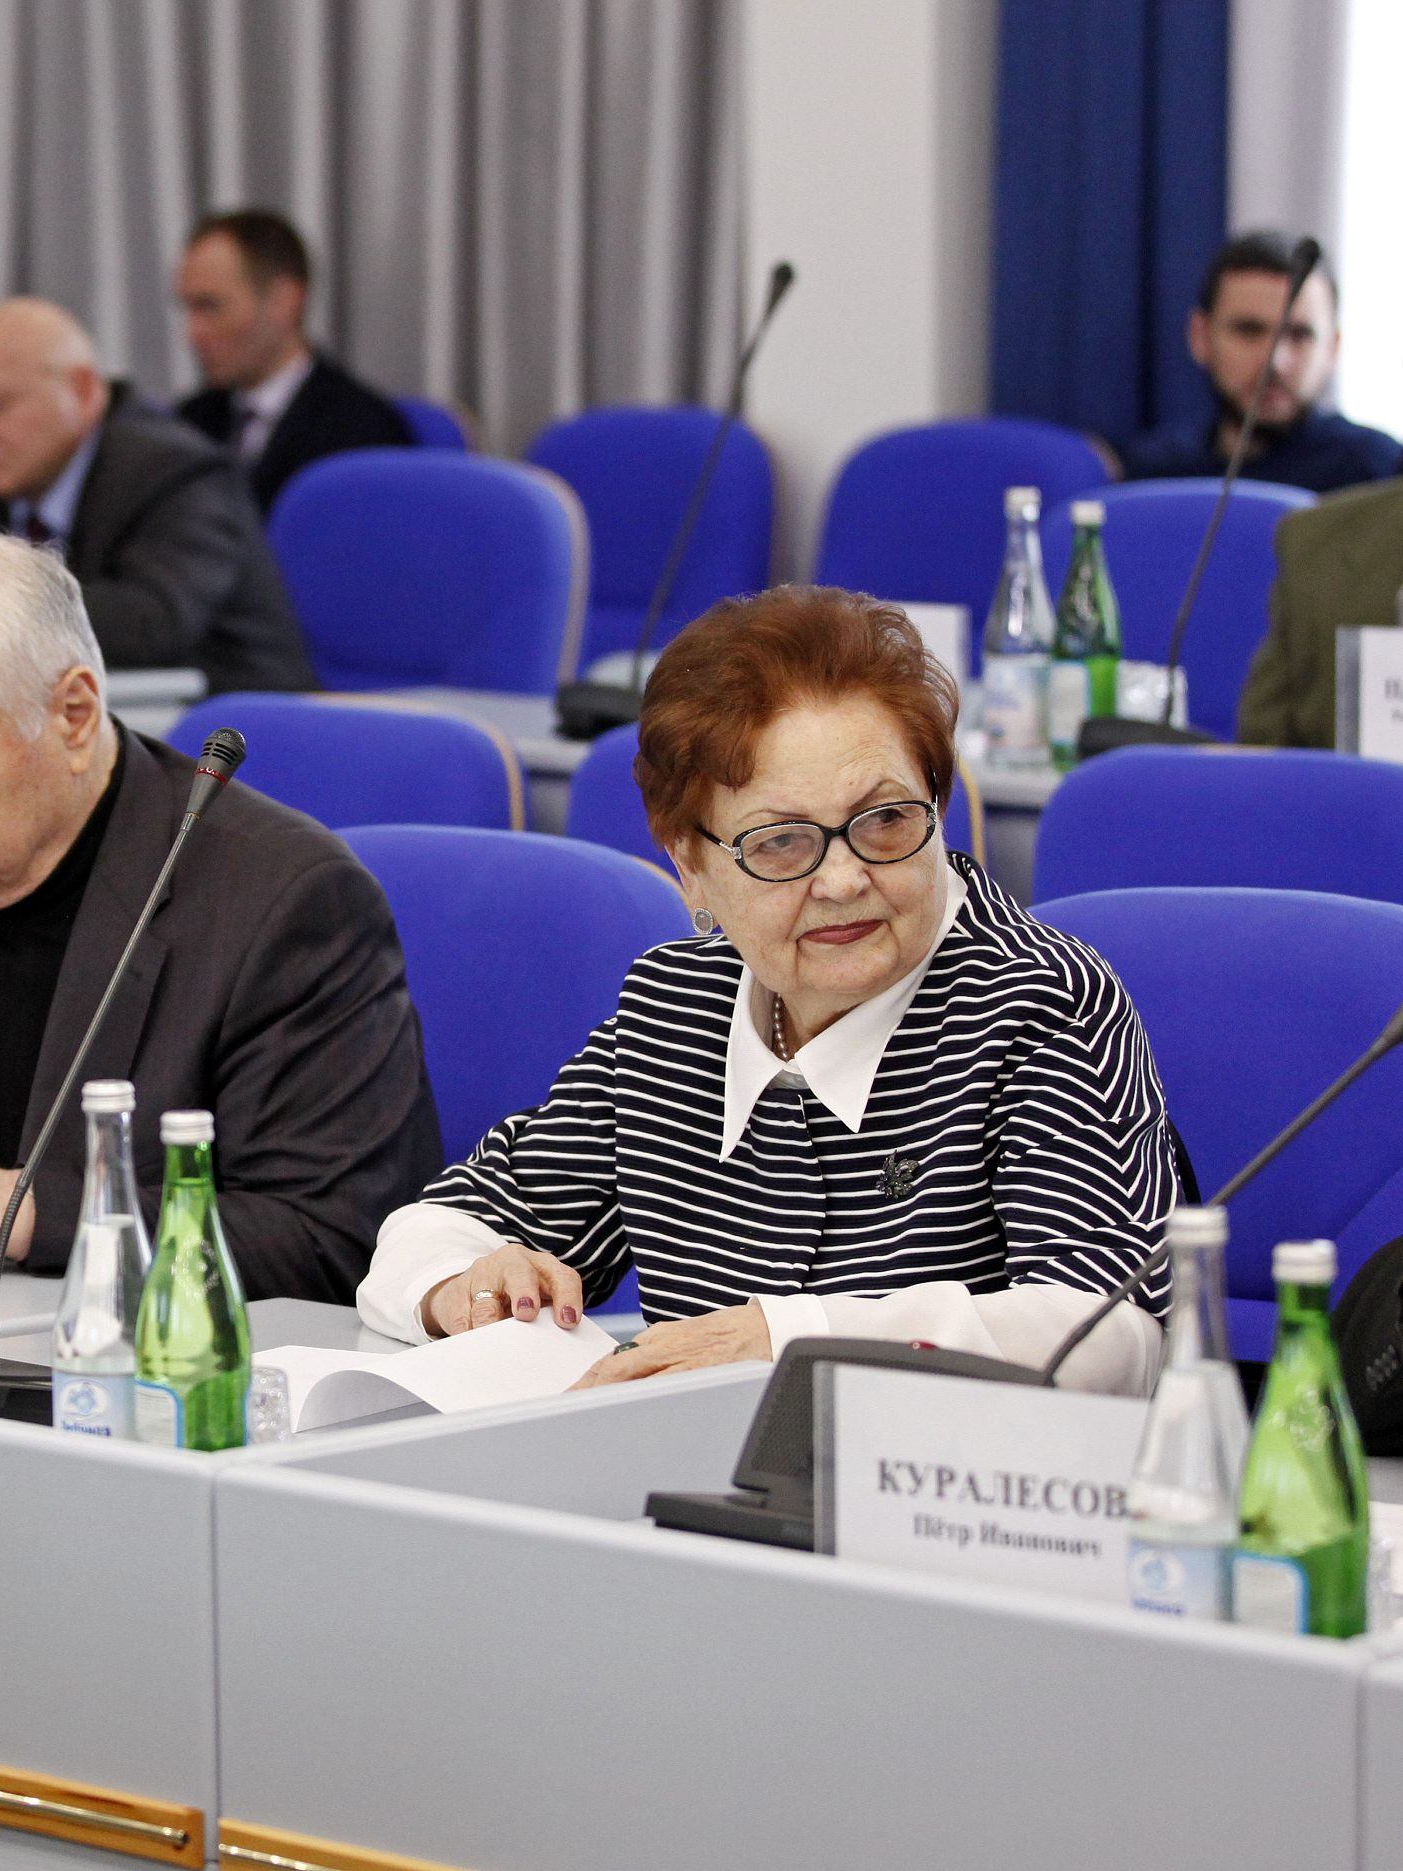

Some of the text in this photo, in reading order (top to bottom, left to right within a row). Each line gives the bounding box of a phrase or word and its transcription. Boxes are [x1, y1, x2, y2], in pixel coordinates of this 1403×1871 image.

[878, 1458, 1130, 1520] КУРАЛЕСОВ
[913, 1512, 1102, 1558] Пётр Иванович
